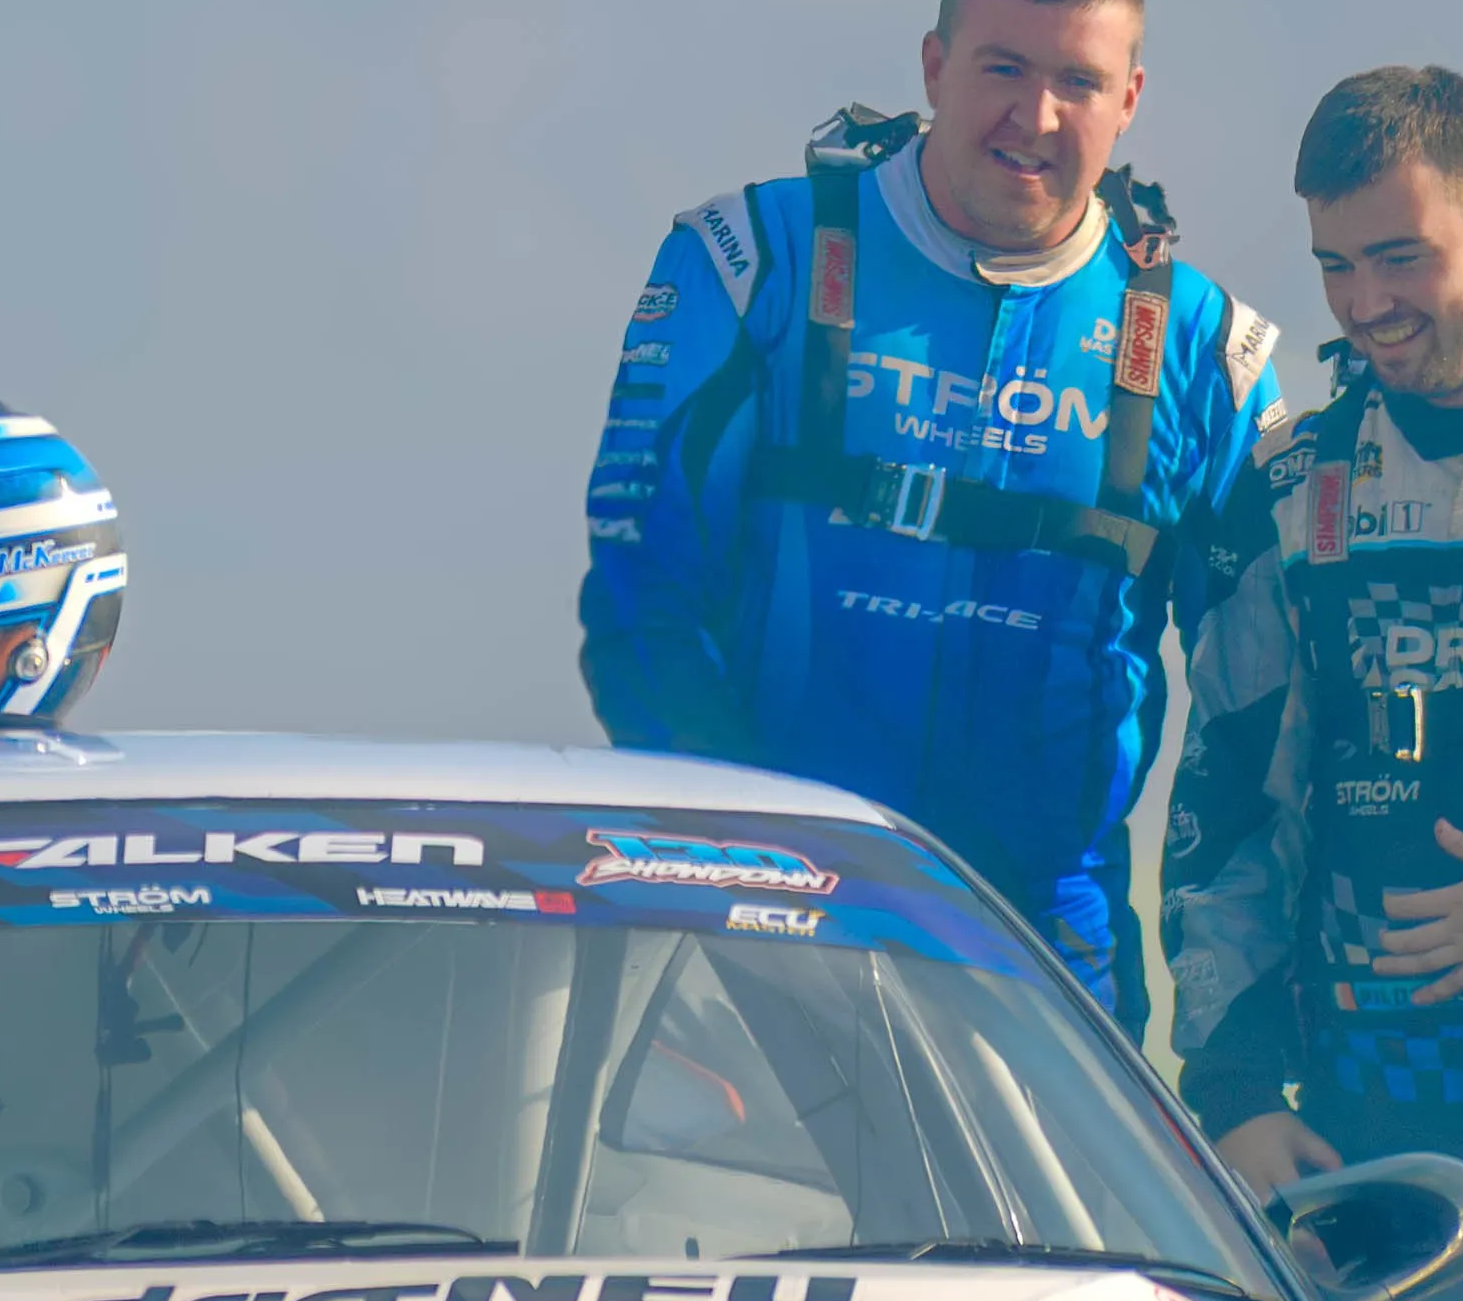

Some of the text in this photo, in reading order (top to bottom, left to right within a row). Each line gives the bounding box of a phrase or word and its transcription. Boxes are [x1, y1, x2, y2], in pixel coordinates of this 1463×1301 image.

[1128, 305, 1158, 386] SIMPSON
[894, 412, 1049, 455] WHEELS
[1335, 773, 1420, 805] STRÖM
[592, 858, 826, 889] SHOWDOWN
[49, 883, 212, 908] STRÖM
[356, 887, 538, 911] HEATWAVE
